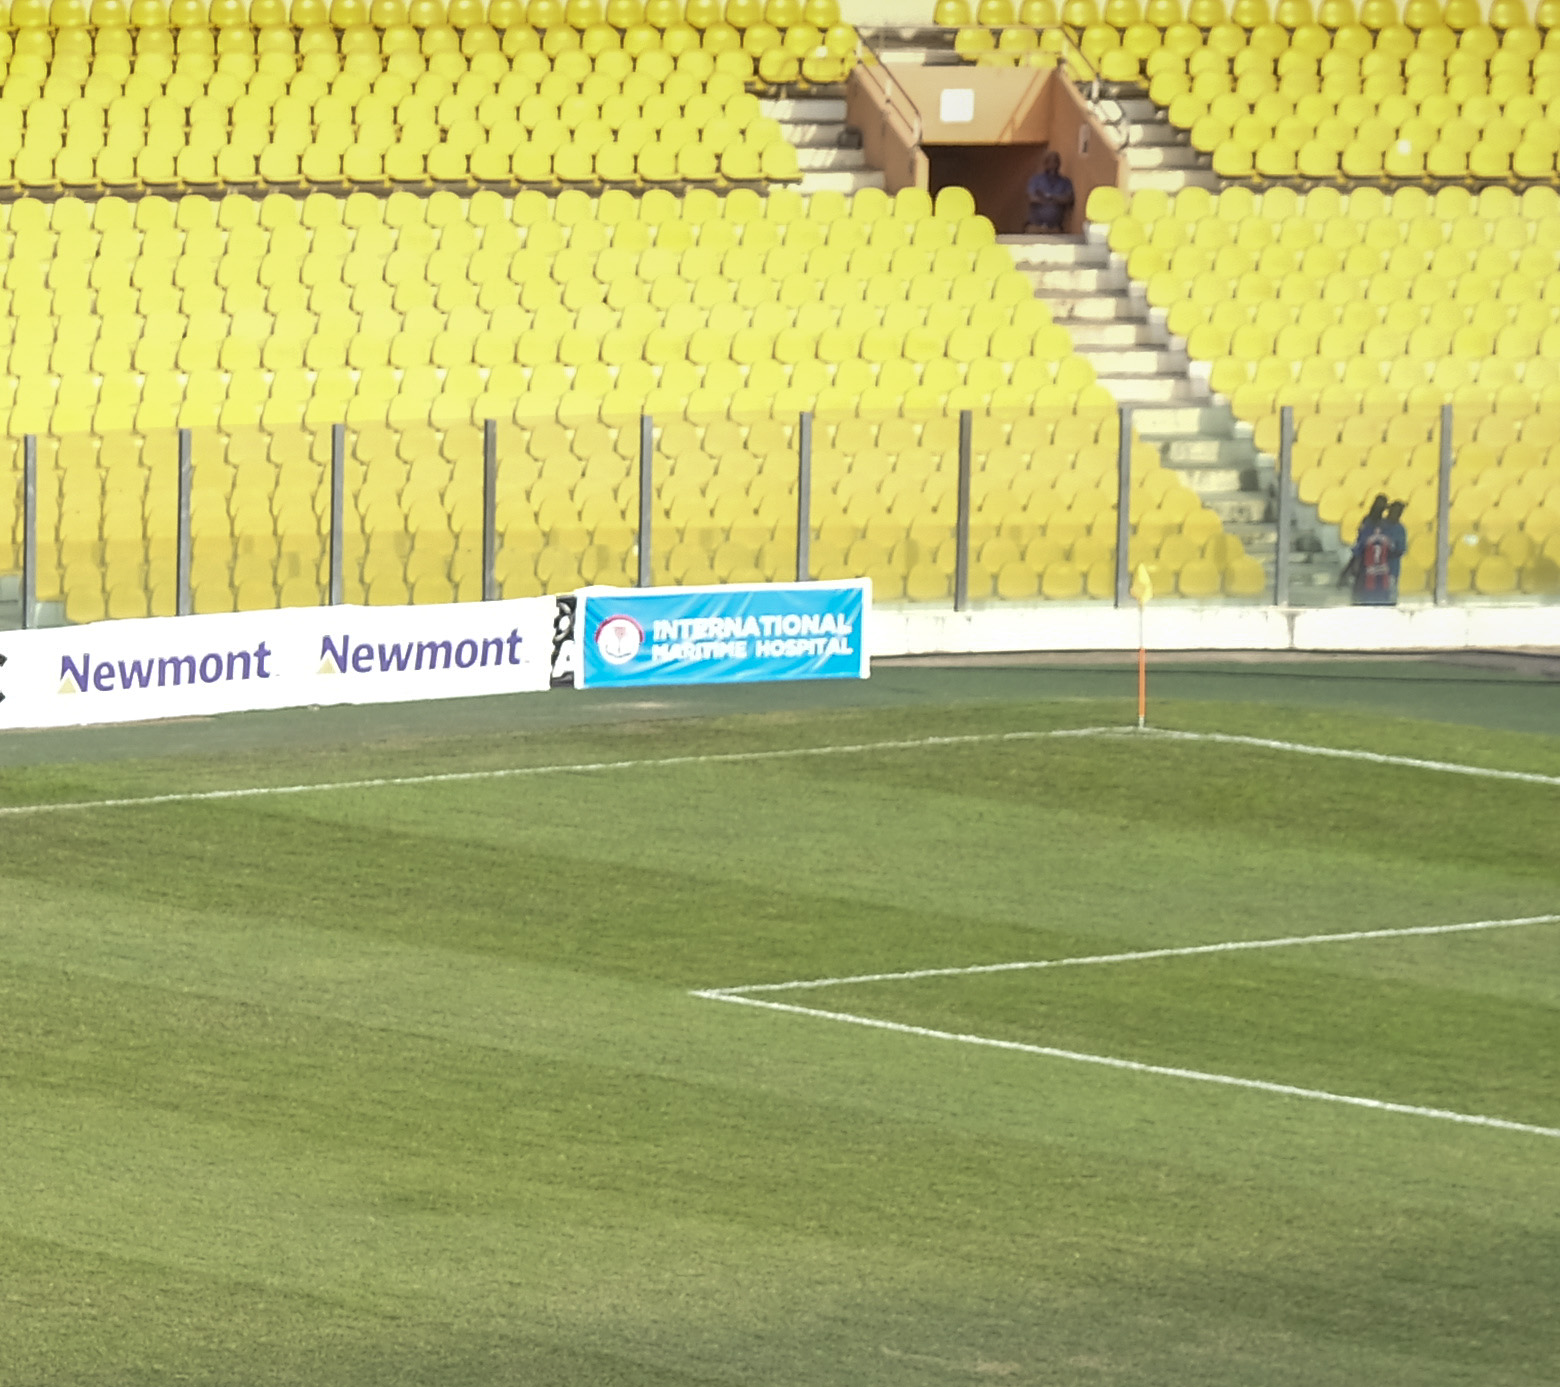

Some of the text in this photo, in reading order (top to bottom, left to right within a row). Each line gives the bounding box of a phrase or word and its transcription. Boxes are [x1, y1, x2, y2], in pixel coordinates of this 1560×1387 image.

[653, 613, 852, 643] INTERNATIONAL
[59, 640, 271, 694] Newmont
[316, 628, 523, 674] Newmont
[652, 637, 854, 661] MARITIME HOSPITAL
